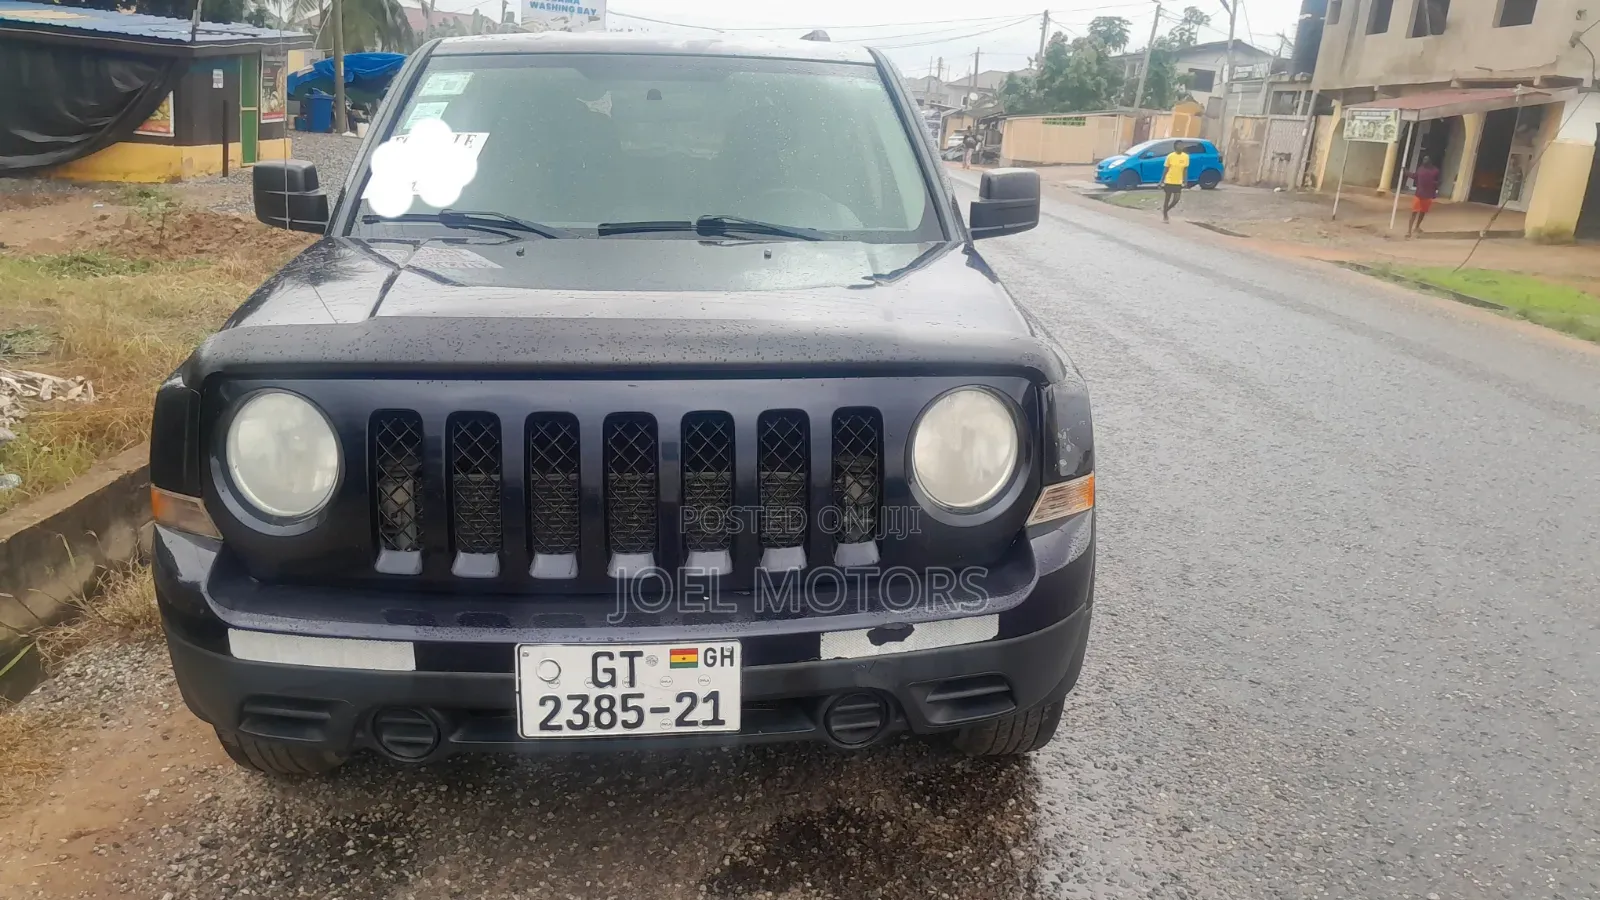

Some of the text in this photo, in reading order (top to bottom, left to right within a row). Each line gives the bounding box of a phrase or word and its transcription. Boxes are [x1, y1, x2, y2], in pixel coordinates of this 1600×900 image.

[530, 1, 576, 13] WASHING
[577, 6, 597, 15] BAY
[591, 650, 644, 689] GT
[703, 646, 734, 668] GH
[538, 690, 726, 731] 2385-21
